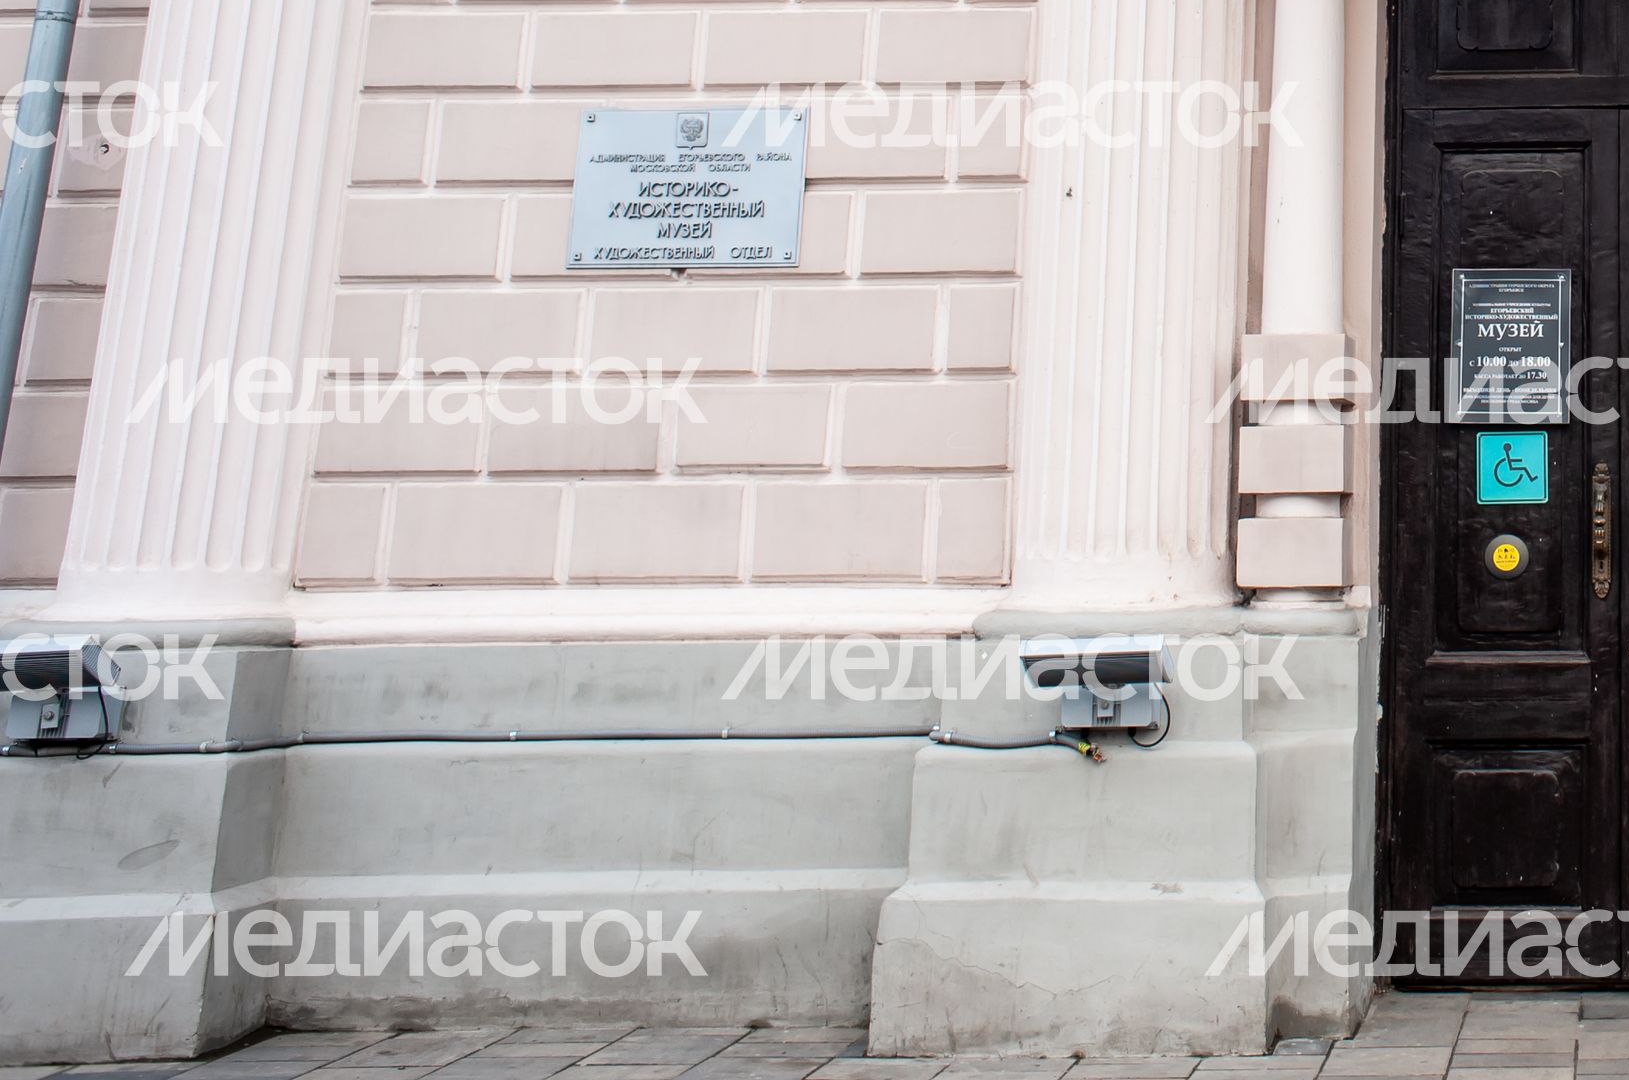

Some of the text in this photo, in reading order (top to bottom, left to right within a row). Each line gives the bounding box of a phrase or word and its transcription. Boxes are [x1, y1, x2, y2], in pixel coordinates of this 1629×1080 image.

[589, 152, 792, 163] АДМИНИСТРАЦИЯ ЕГОРЬЕВСКОГО РАЙОНА
[630, 163, 751, 173] МОСКОВСКОЙ ОБЛАСТИ
[638, 181, 739, 197] ИСТОРИКО-
[608, 200, 765, 219] ХУДОЖЕСТВЕННЫЙ
[657, 221, 713, 239] МУЗЕЙ
[593, 246, 772, 260] ХУДОЖЕСТВЕННЫЙ ОТДЕЛ
[1477, 320, 1544, 340] МУЗЕЙ
[1477, 356, 1507, 367] 10.00
[1521, 356, 1551, 367] 18.00
